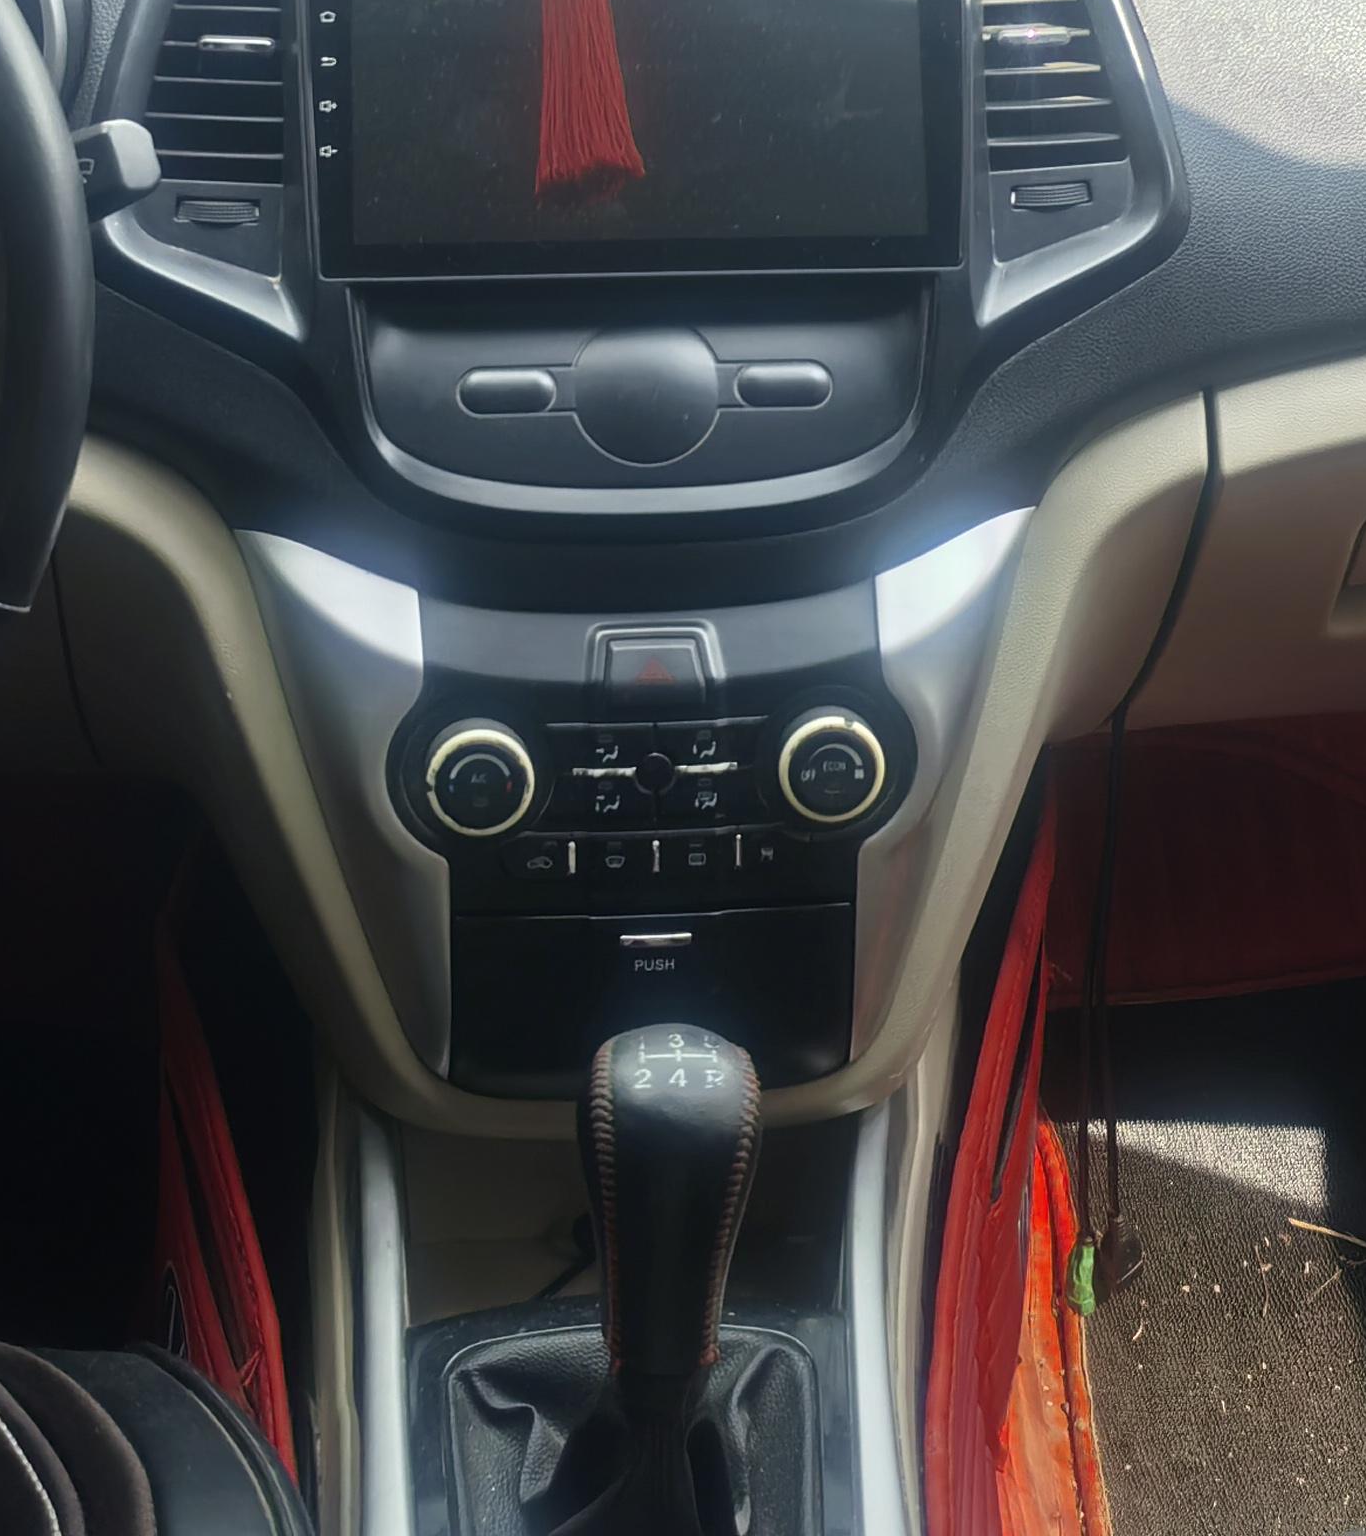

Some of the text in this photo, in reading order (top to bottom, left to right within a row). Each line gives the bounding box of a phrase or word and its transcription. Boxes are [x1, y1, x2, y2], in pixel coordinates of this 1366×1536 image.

[635, 959, 675, 971] PUSH
[667, 1034, 685, 1048] 3
[633, 1068, 652, 1089] 2
[668, 1068, 688, 1088] 4
